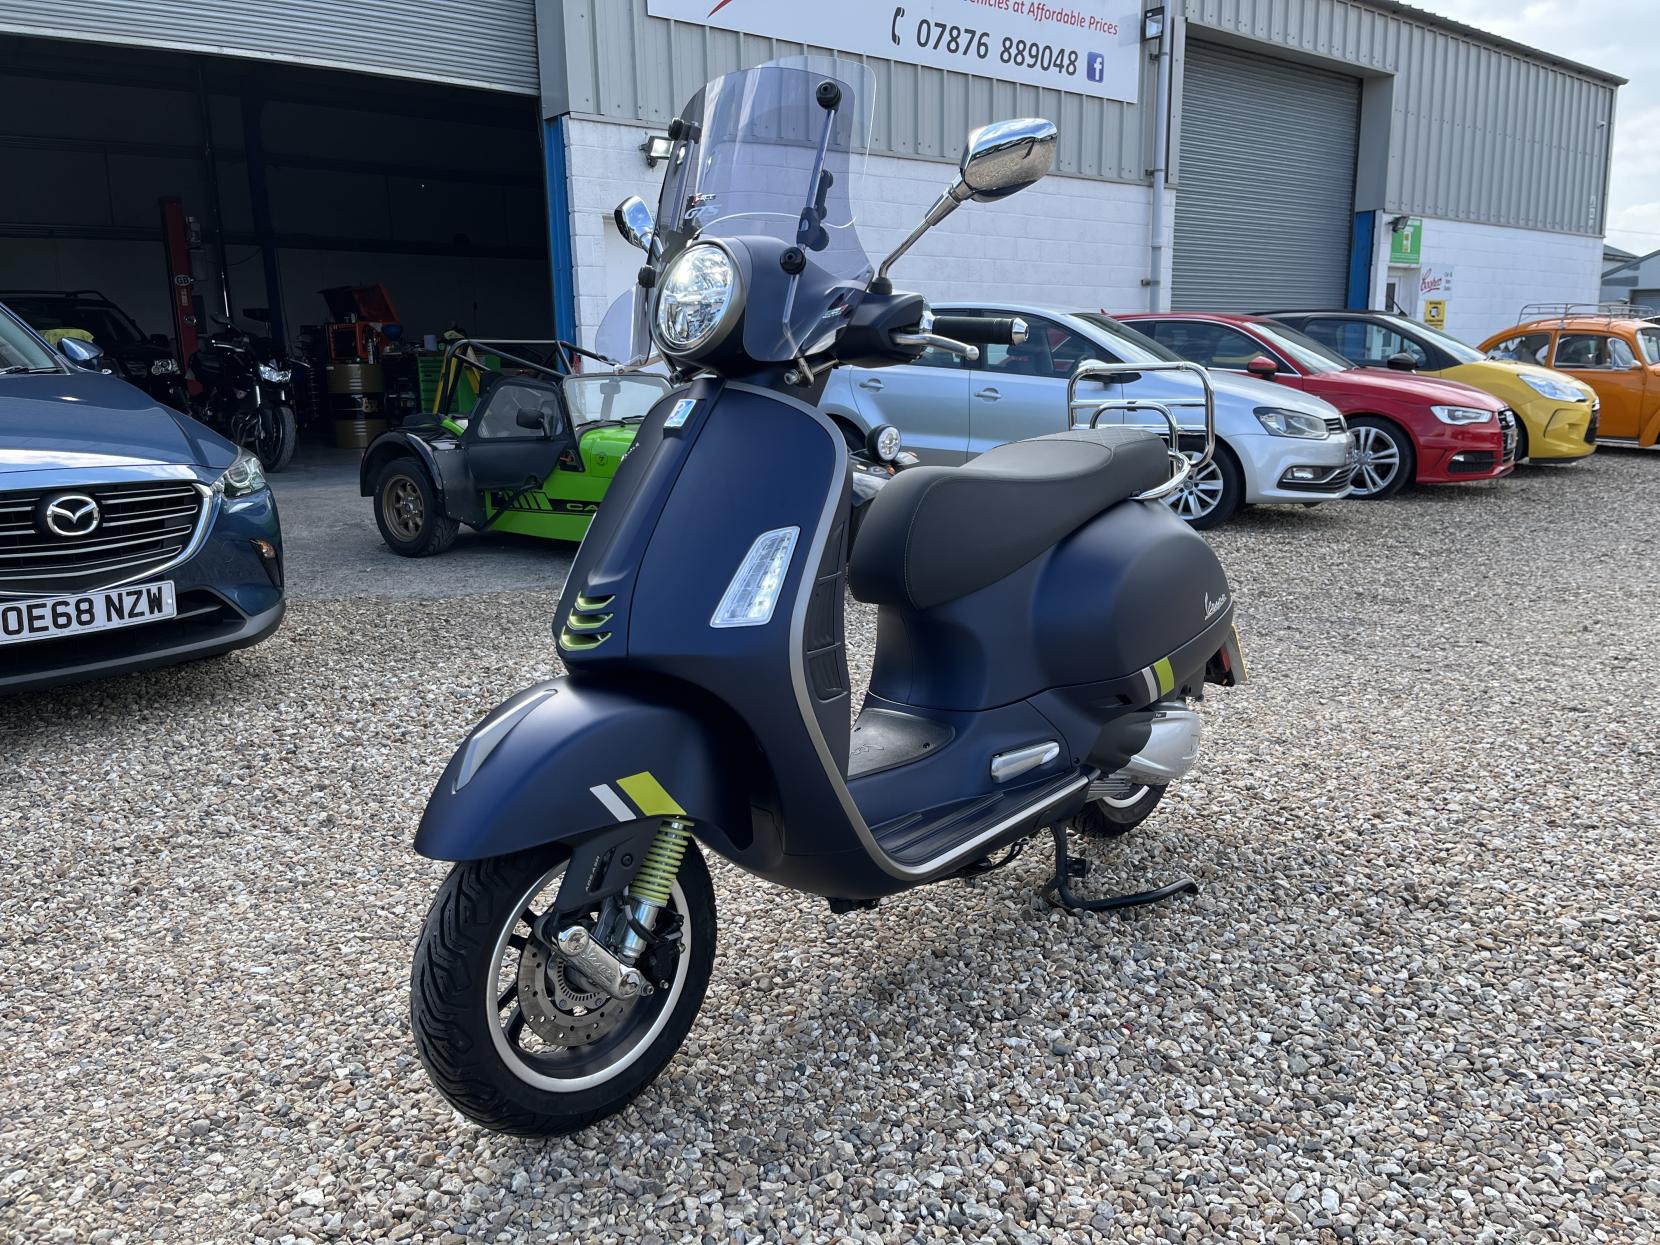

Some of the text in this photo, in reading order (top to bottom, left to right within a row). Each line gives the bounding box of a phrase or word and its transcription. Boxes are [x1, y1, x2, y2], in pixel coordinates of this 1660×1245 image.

[1012, 1, 1025, 15] at
[1027, 2, 1086, 28] Affordable
[1088, 15, 1119, 36] Prices
[916, 18, 990, 60] 07876
[999, 36, 1079, 76] 889048
[1, 586, 164, 636] OE68 NZW
